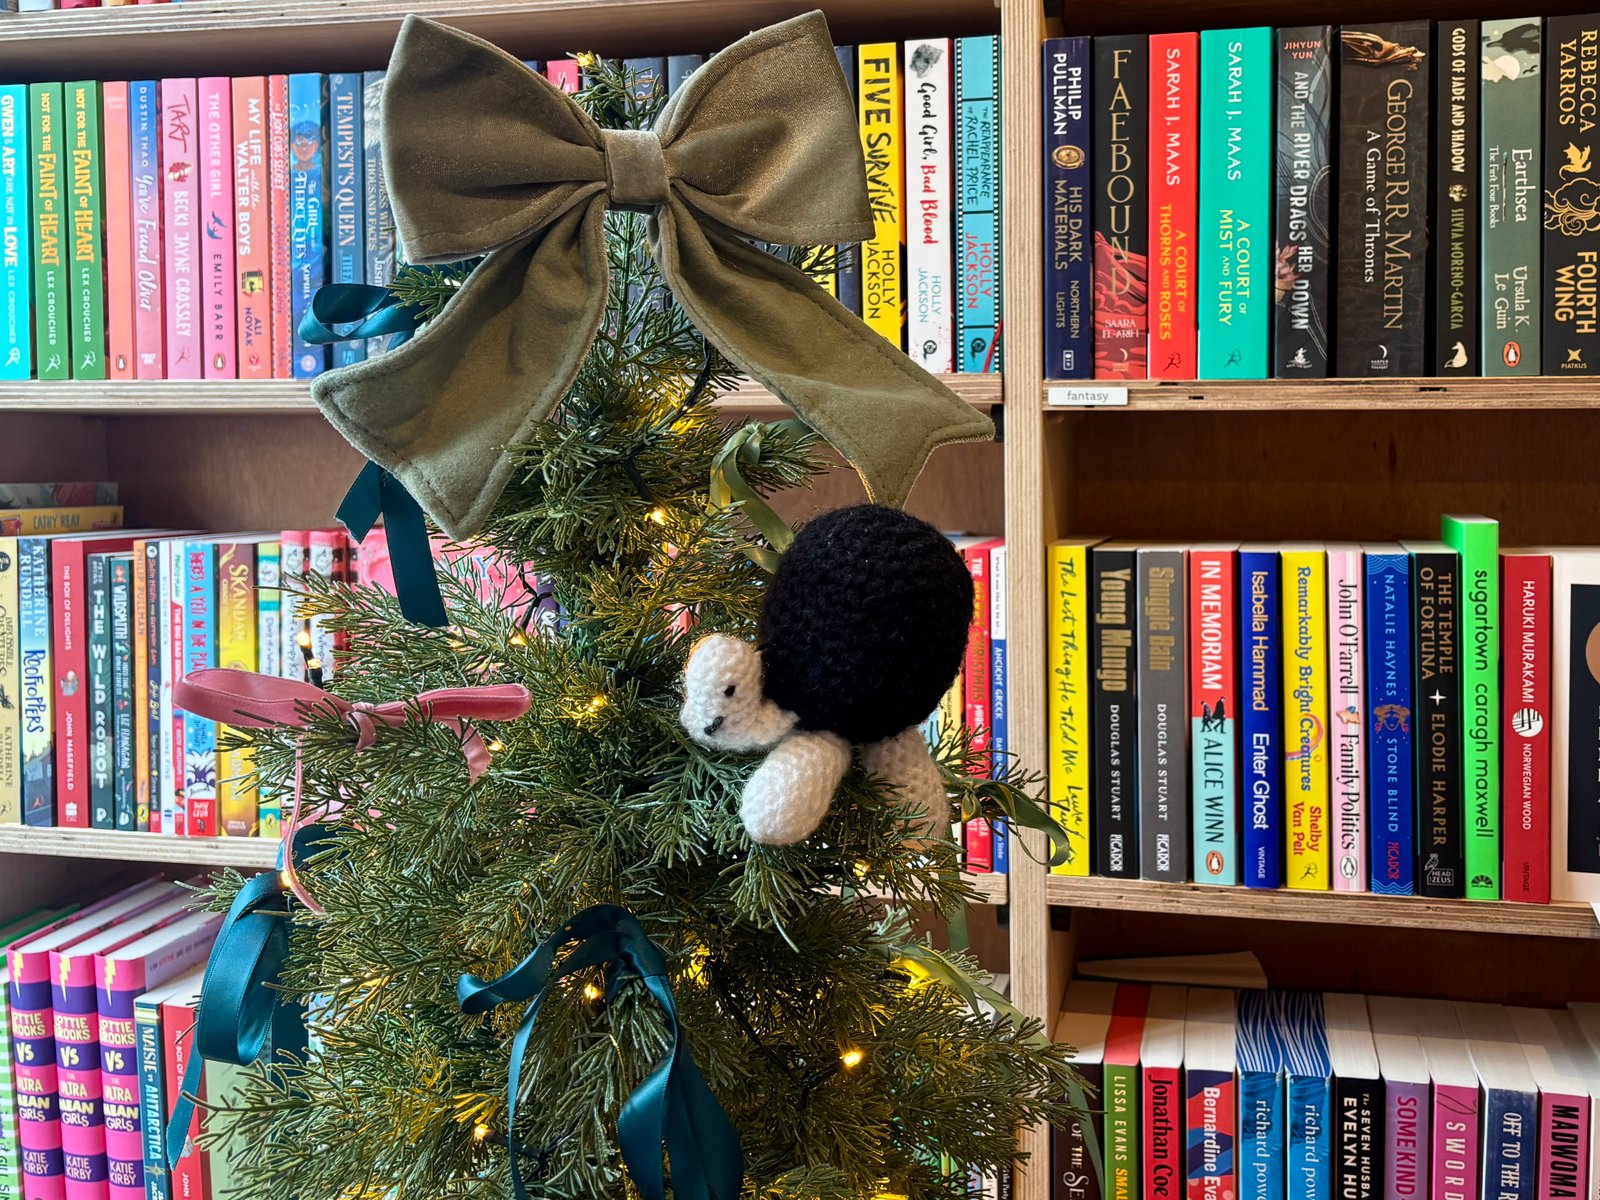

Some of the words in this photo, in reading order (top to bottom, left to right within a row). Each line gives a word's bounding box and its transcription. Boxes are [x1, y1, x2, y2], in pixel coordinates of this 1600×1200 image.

[1451, 28, 1465, 56] GODS
[1228, 42, 1241, 102] SARAH
[1294, 72, 1309, 99] AND
[1452, 60, 1464, 73] OF
[1452, 76, 1464, 102] JADE
[1559, 40, 1575, 125] YARROS
[1579, 30, 1597, 133] REBECCA
[76, 88, 85, 108] NOT
[139, 87, 148, 130] DUSTIN
[209, 93, 219, 121] THE
[248, 99, 259, 122] MY
[918, 82, 937, 118] Good
[1053, 53, 1067, 135] PULLMAN
[1068, 67, 1081, 120] PHILIP
[1226, 110, 1242, 120] J.
[1291, 104, 1305, 128] THE
[1452, 105, 1464, 126] AND
[77, 111, 86, 130] FOR
[77, 131, 86, 148] THE
[336, 92, 354, 185] TEMPEST'S
[919, 125, 938, 160] Girl,
[966, 116, 978, 165] RACHEL
[1366, 130, 1379, 143] A
[1386, 79, 1412, 175] GEORGE
[209, 125, 221, 166] OTHER
[249, 130, 261, 165] LIFE
[980, 121, 991, 198] REAPPEARANCE
[1227, 127, 1241, 181] MAAS
[1293, 133, 1311, 179] RIVER
[1452, 129, 1464, 173] SHADOW
[1489, 145, 1499, 162] The
[73, 149, 92, 196] FAINT
[210, 170, 222, 198] GIRL
[237, 140, 249, 209] WALTER
[921, 164, 937, 193] Bad
[966, 168, 978, 205] PRICE
[1107, 49, 1135, 297] FAEBOUND
[1365, 148, 1379, 191] Game
[1489, 164, 1499, 182] First
[1511, 149, 1536, 222] Earthsea
[80, 196, 88, 208] OF
[174, 191, 188, 226] BECKI
[1069, 187, 1082, 212] HIS
[1289, 185, 1307, 241] DRAGS
[1365, 198, 1380, 213] of
[1489, 184, 1499, 202] Four
[75, 209, 94, 263] HEART
[239, 212, 250, 255] BOYS
[337, 188, 355, 246] QUEEN
[919, 199, 939, 244] Blood
[1055, 180, 1068, 270] MATERIALS
[1159, 203, 1171, 266] THORNS
[1450, 208, 1464, 239] SILVIA
[1489, 204, 1499, 228] Books
[175, 232, 189, 273] JAYNE
[1069, 218, 1082, 262] DARK
[1297, 246, 1312, 273] HER
[1364, 218, 1379, 283] Thrones
[213, 254, 223, 295] EMILY
[965, 231, 979, 309] JACKSON
[980, 243, 992, 297] HOLLY
[1162, 269, 1170, 288] AND
[1384, 231, 1411, 330] MARTIN
[1450, 242, 1464, 330] MORENO-GARCIA
[1495, 273, 1509, 291] Le
[1513, 265, 1528, 311] Ursula
[1575, 251, 1597, 333] FOURTH
[83, 288, 91, 342] CROUCHER
[176, 278, 191, 336] CROSSLEY
[918, 268, 929, 323] JACKSON
[930, 275, 941, 315] HOLLY
[1055, 292, 1065, 328] LIGHTS
[1070, 280, 1080, 338] NORTHERN
[1159, 291, 1172, 341] ROSES
[1292, 279, 1308, 330] DOWN
[1496, 297, 1510, 330] Guin
[1555, 265, 1575, 322] WING
[214, 303, 224, 340] BARR
[1105, 319, 1136, 328] SAARA
[1514, 315, 1529, 332] K.
[1067, 390, 1109, 403] fantasy
[21, 555, 33, 628] RUNDELL
[34, 545, 46, 637] KATHERINE
[1201, 561, 1220, 579] IN
[1420, 567, 1433, 592] OF
[1438, 573, 1451, 607] THE
[64, 599, 71, 610] OF
[114, 585, 127, 639] WILDSMITH
[1095, 569, 1131, 624] Young
[1144, 567, 1174, 630] Shuggie
[1252, 571, 1268, 632] Isabella
[1294, 566, 1311, 660] Remarkably
[1384, 574, 1395, 635] NATALIE
[1522, 580, 1535, 629] HARUKI
[64, 612, 72, 650] DELIGHTS
[1201, 584, 1222, 690] MEMORIAM
[1420, 597, 1434, 680] FORTUNA
[1439, 612, 1452, 673] TEMPLE
[1469, 570, 1491, 671] sugartown
[994, 647, 1003, 687] ANCIENT
[1097, 629, 1131, 692] Mungo
[1149, 636, 1174, 670] Bain
[1253, 637, 1269, 711] Hammad
[1386, 640, 1397, 696] HAYNES
[1522, 632, 1535, 703] MURAKAMI
[24, 649, 46, 733] ROOFTOPPERS
[995, 689, 1004, 719] GREEK
[1295, 665, 1313, 713] Bright
[1110, 704, 1120, 765] DOUGLAS
[1471, 683, 1492, 749] caragh
[1204, 738, 1223, 788] ALICE
[1253, 733, 1269, 777] Enter
[1300, 718, 1314, 791] Creatures
[1336, 733, 1359, 789] Family
[1387, 738, 1398, 783] STONE
[1431, 713, 1444, 772] ELODIE
[1522, 743, 1532, 798] NORWEGIAN
[1111, 769, 1121, 821] STUART
[1253, 780, 1270, 830] Ghost
[1292, 801, 1304, 828] Van
[1387, 789, 1399, 832] BLIND
[1432, 780, 1446, 845] HARPER
[1475, 759, 1493, 837] maxwell
[1522, 801, 1531, 829] WOOD
[1205, 796, 1224, 843] WINN
[1306, 806, 1321, 851] Shelby
[1342, 791, 1359, 849] Politics
[1257, 846, 1265, 879] VINTAGE
[1293, 832, 1305, 855] Pelt
[1387, 842, 1399, 879] PICADOR
[105, 1052, 124, 1072] VS
[142, 1026, 157, 1073] MAISIE
[1114, 1076, 1127, 1112] LISSA
[105, 1117, 133, 1131] GIRLS
[145, 1085, 161, 1160] ANTARCTICA
[1148, 1075, 1173, 1159] Jonathan
[1204, 1087, 1220, 1171] Bernardine
[1256, 1100, 1271, 1158] richard
[1305, 1105, 1320, 1162] richard
[1343, 1097, 1357, 1166] EVELYN
[1361, 1109, 1370, 1151] SEVEN
[1397, 1096, 1417, 1146] SOME
[1503, 1112, 1521, 1135] OFF
[66, 1157, 90, 1168] KATIE
[1115, 1120, 1127, 1161] EVANS
[1502, 1142, 1520, 1158] TO
[66, 1167, 92, 1180] KIRBY
[110, 1161, 134, 1173] KATIE
[110, 1172, 136, 1185] KIRBY
[1154, 1164, 1173, 1197] Coe
[1396, 1152, 1416, 1193] KIND
[1501, 1163, 1520, 1187] THE
